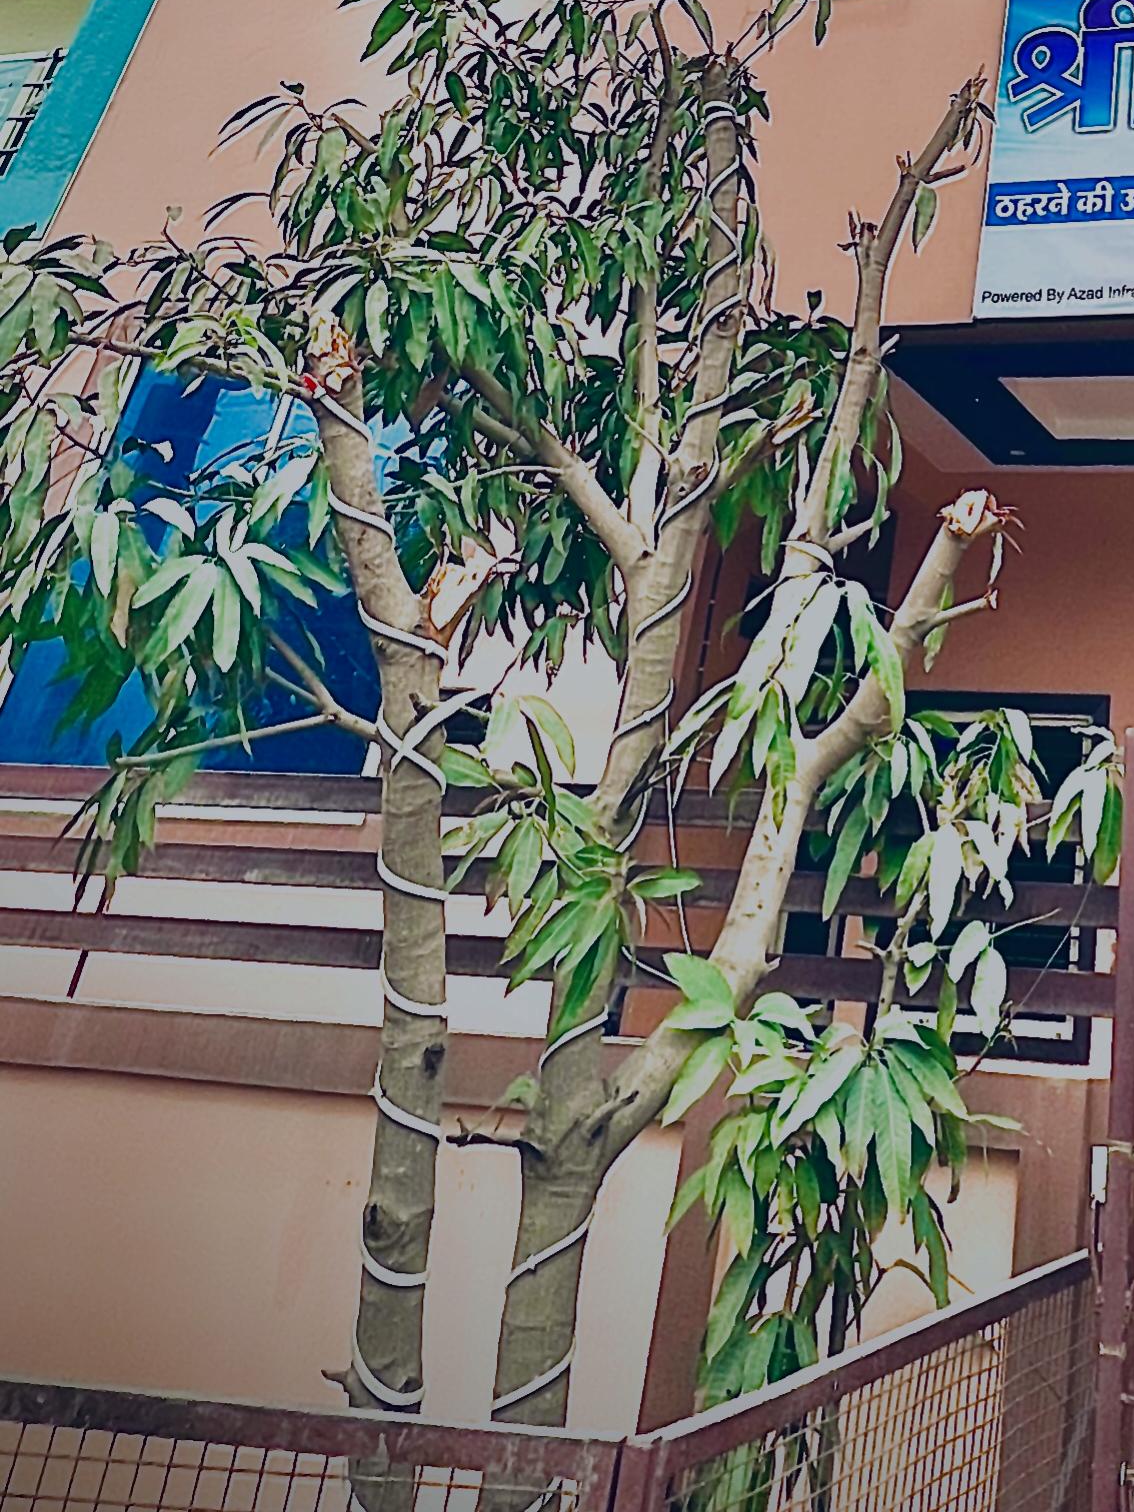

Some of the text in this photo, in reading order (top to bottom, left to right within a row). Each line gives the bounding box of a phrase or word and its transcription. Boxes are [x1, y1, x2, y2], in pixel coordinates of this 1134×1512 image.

[994, 182, 1072, 221] ठहरने
[1075, 180, 1114, 214] की
[981, 288, 1042, 304] Powered
[1046, 288, 1065, 304] By
[1067, 286, 1104, 301] Azad
